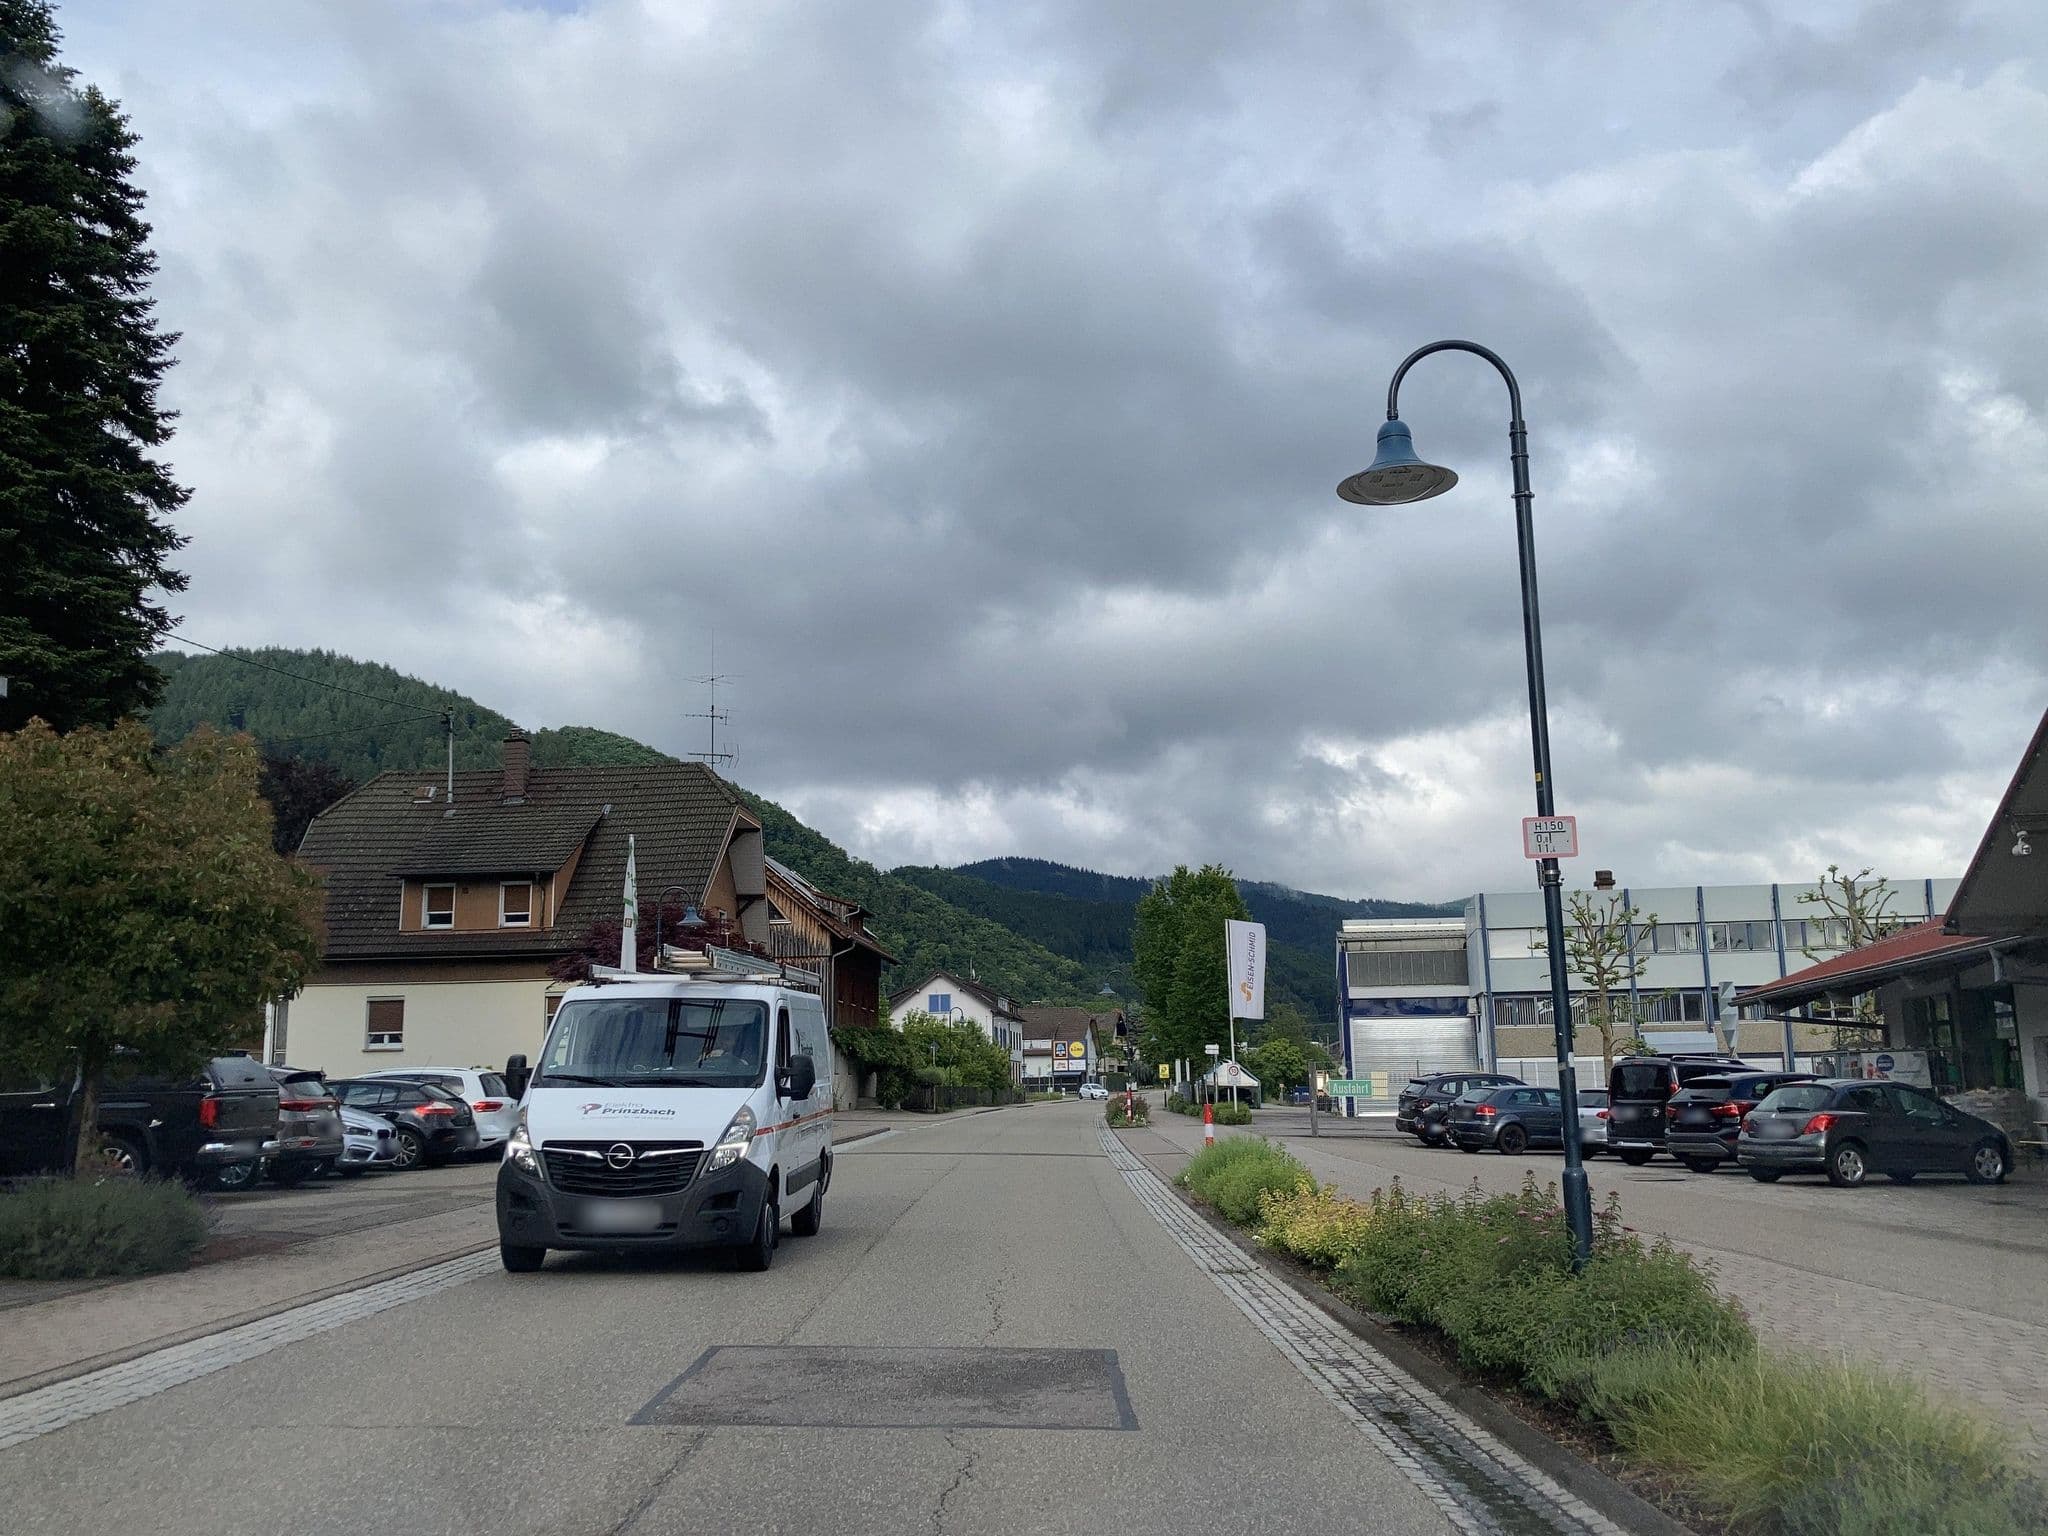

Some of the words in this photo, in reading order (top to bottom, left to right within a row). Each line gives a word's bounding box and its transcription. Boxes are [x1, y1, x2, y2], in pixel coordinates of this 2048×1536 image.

[1534, 821, 1563, 831] H150
[1247, 931, 1256, 990] EISEN-SCHMID
[1333, 1083, 1369, 1094] Ausfahrt
